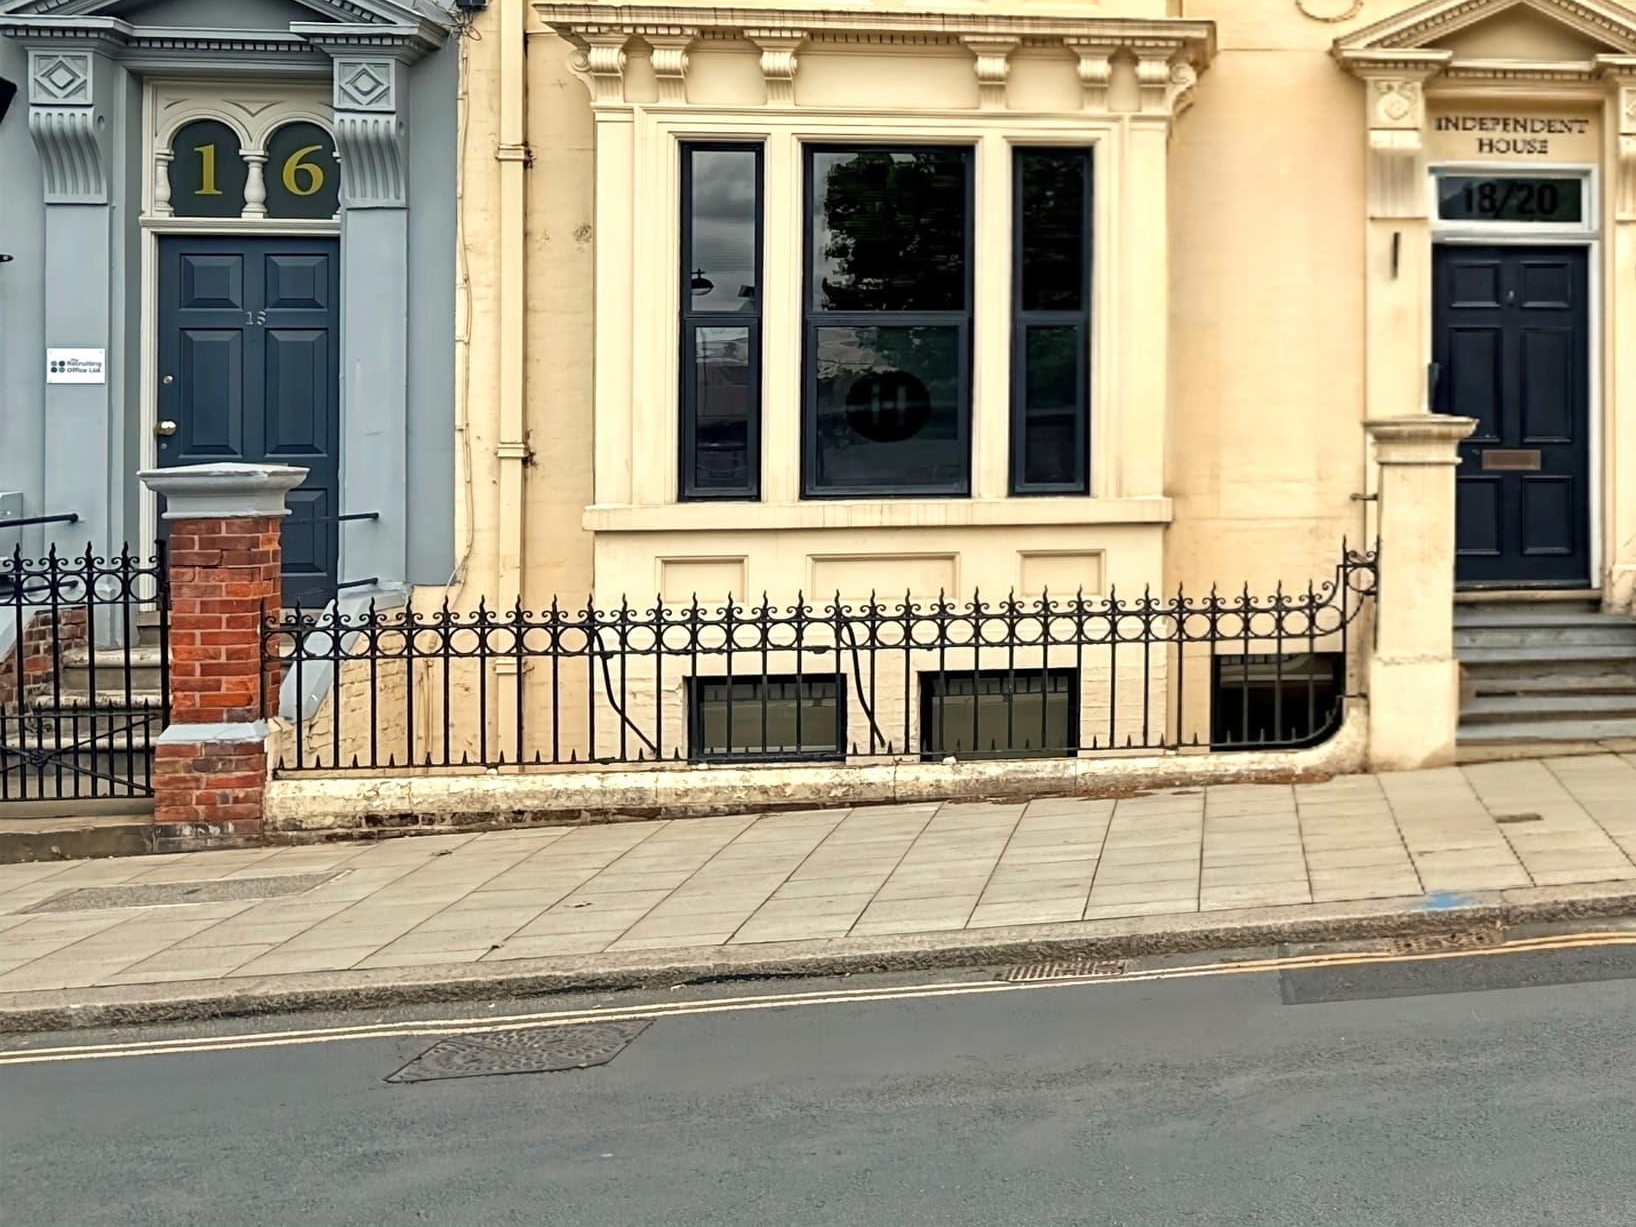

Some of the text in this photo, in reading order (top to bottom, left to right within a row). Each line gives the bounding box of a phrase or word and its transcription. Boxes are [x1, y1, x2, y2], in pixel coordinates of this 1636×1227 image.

[1435, 116, 1590, 134] INDEPENDENT
[1476, 138, 1549, 155] HOUSE
[1463, 181, 1559, 218] 18/20
